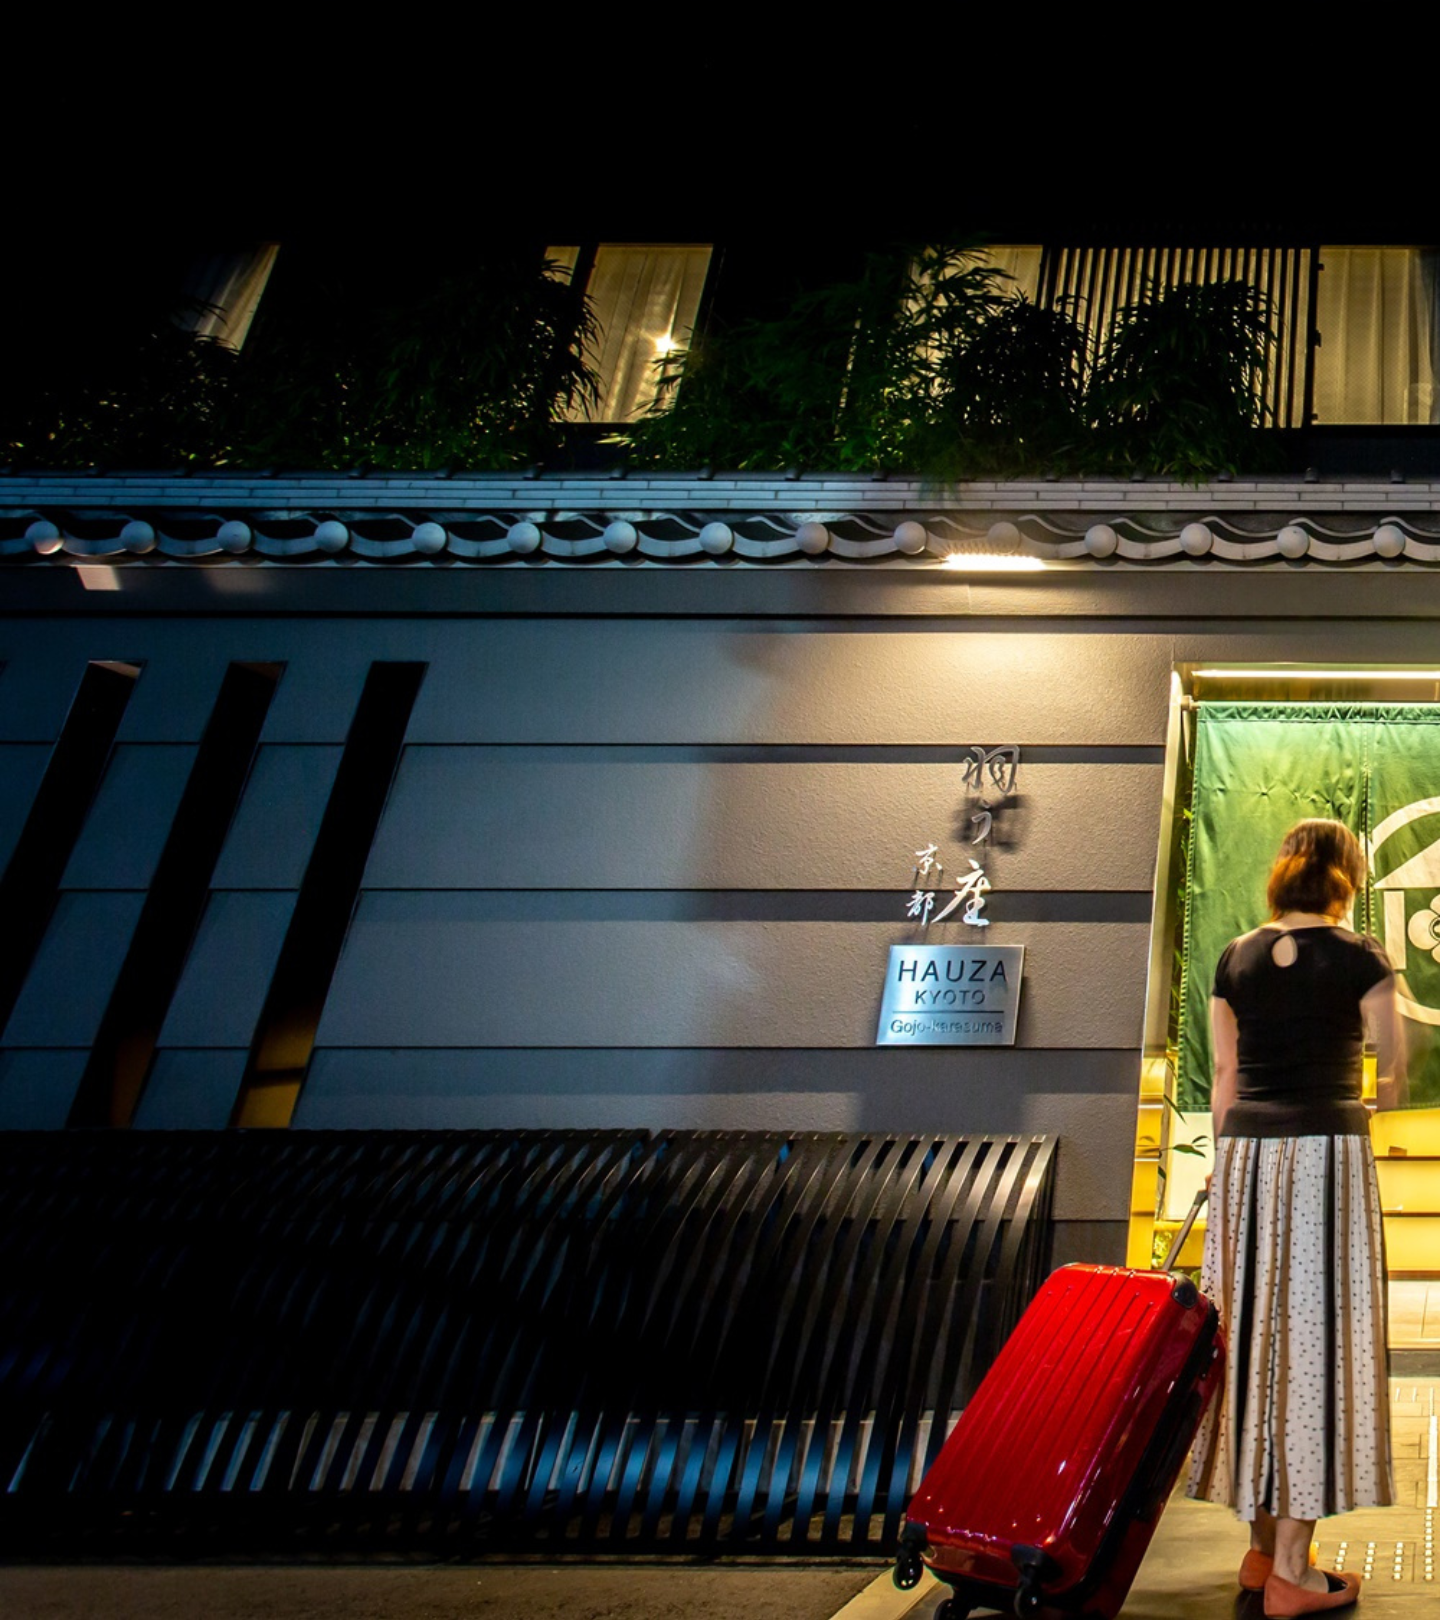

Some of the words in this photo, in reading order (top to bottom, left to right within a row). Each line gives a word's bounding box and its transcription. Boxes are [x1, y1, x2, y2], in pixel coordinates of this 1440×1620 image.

[905, 843, 943, 926] 京都
[898, 960, 1007, 982] HAUZA
[914, 989, 985, 1005] KYOTO
[890, 1019, 1003, 1036] Gojo-karasuma
